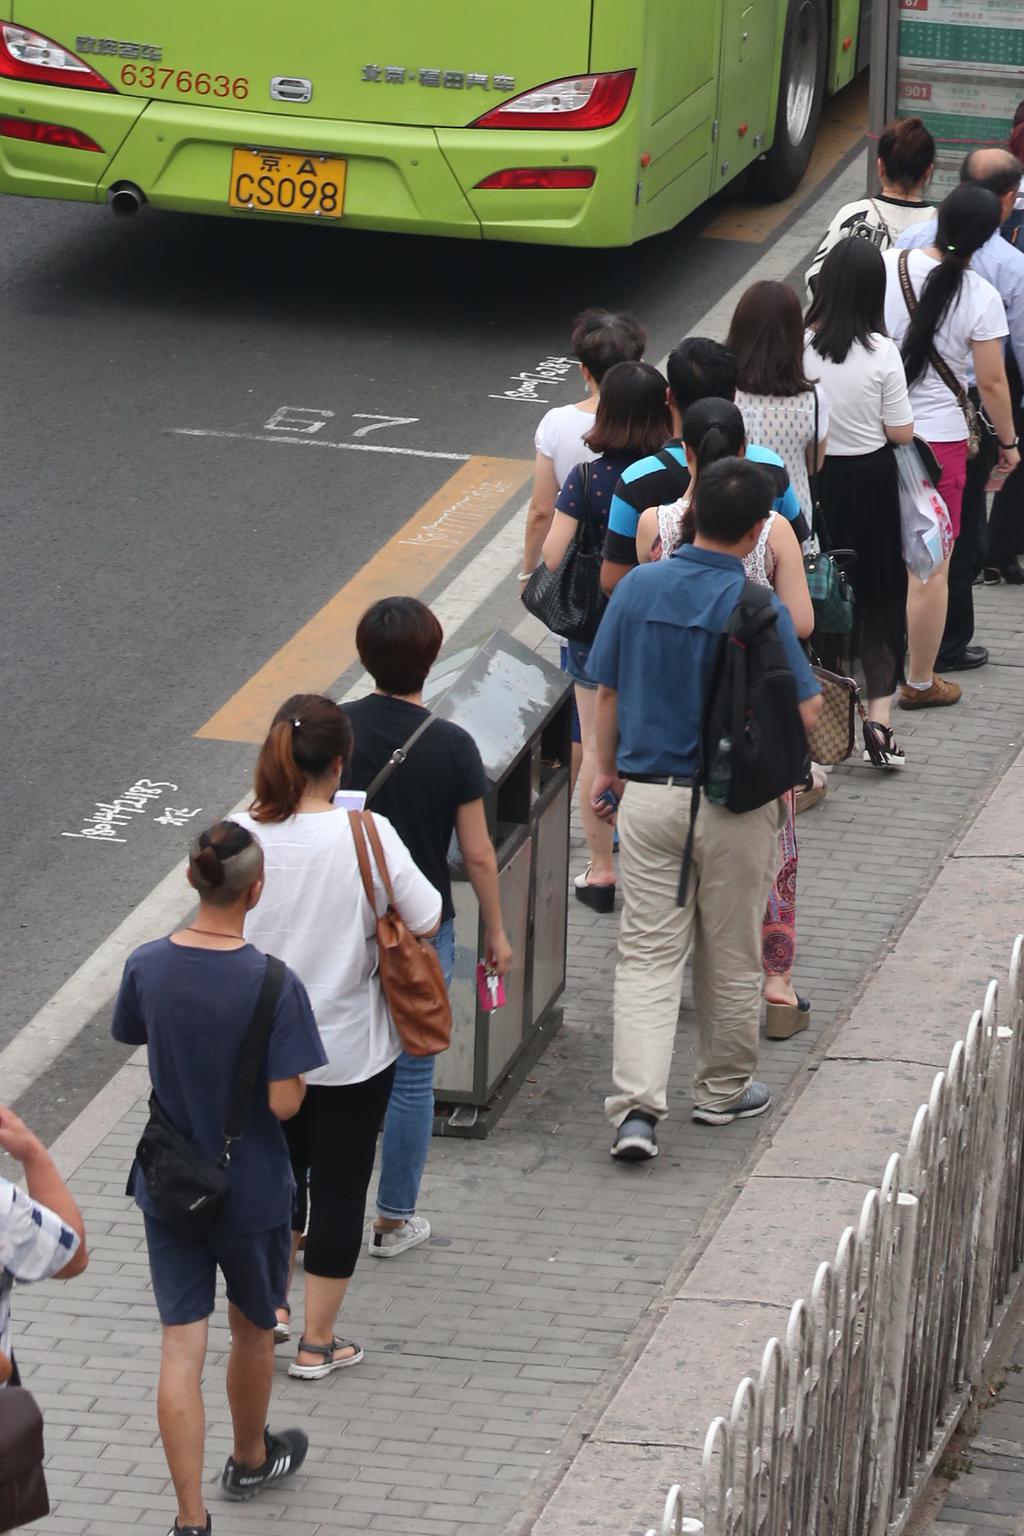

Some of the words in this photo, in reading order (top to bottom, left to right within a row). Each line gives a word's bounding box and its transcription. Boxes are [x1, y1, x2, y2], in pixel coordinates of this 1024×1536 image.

[120, 64, 249, 100] 6376636
[905, 86, 928, 98] 901
[236, 173, 338, 212] CS098
